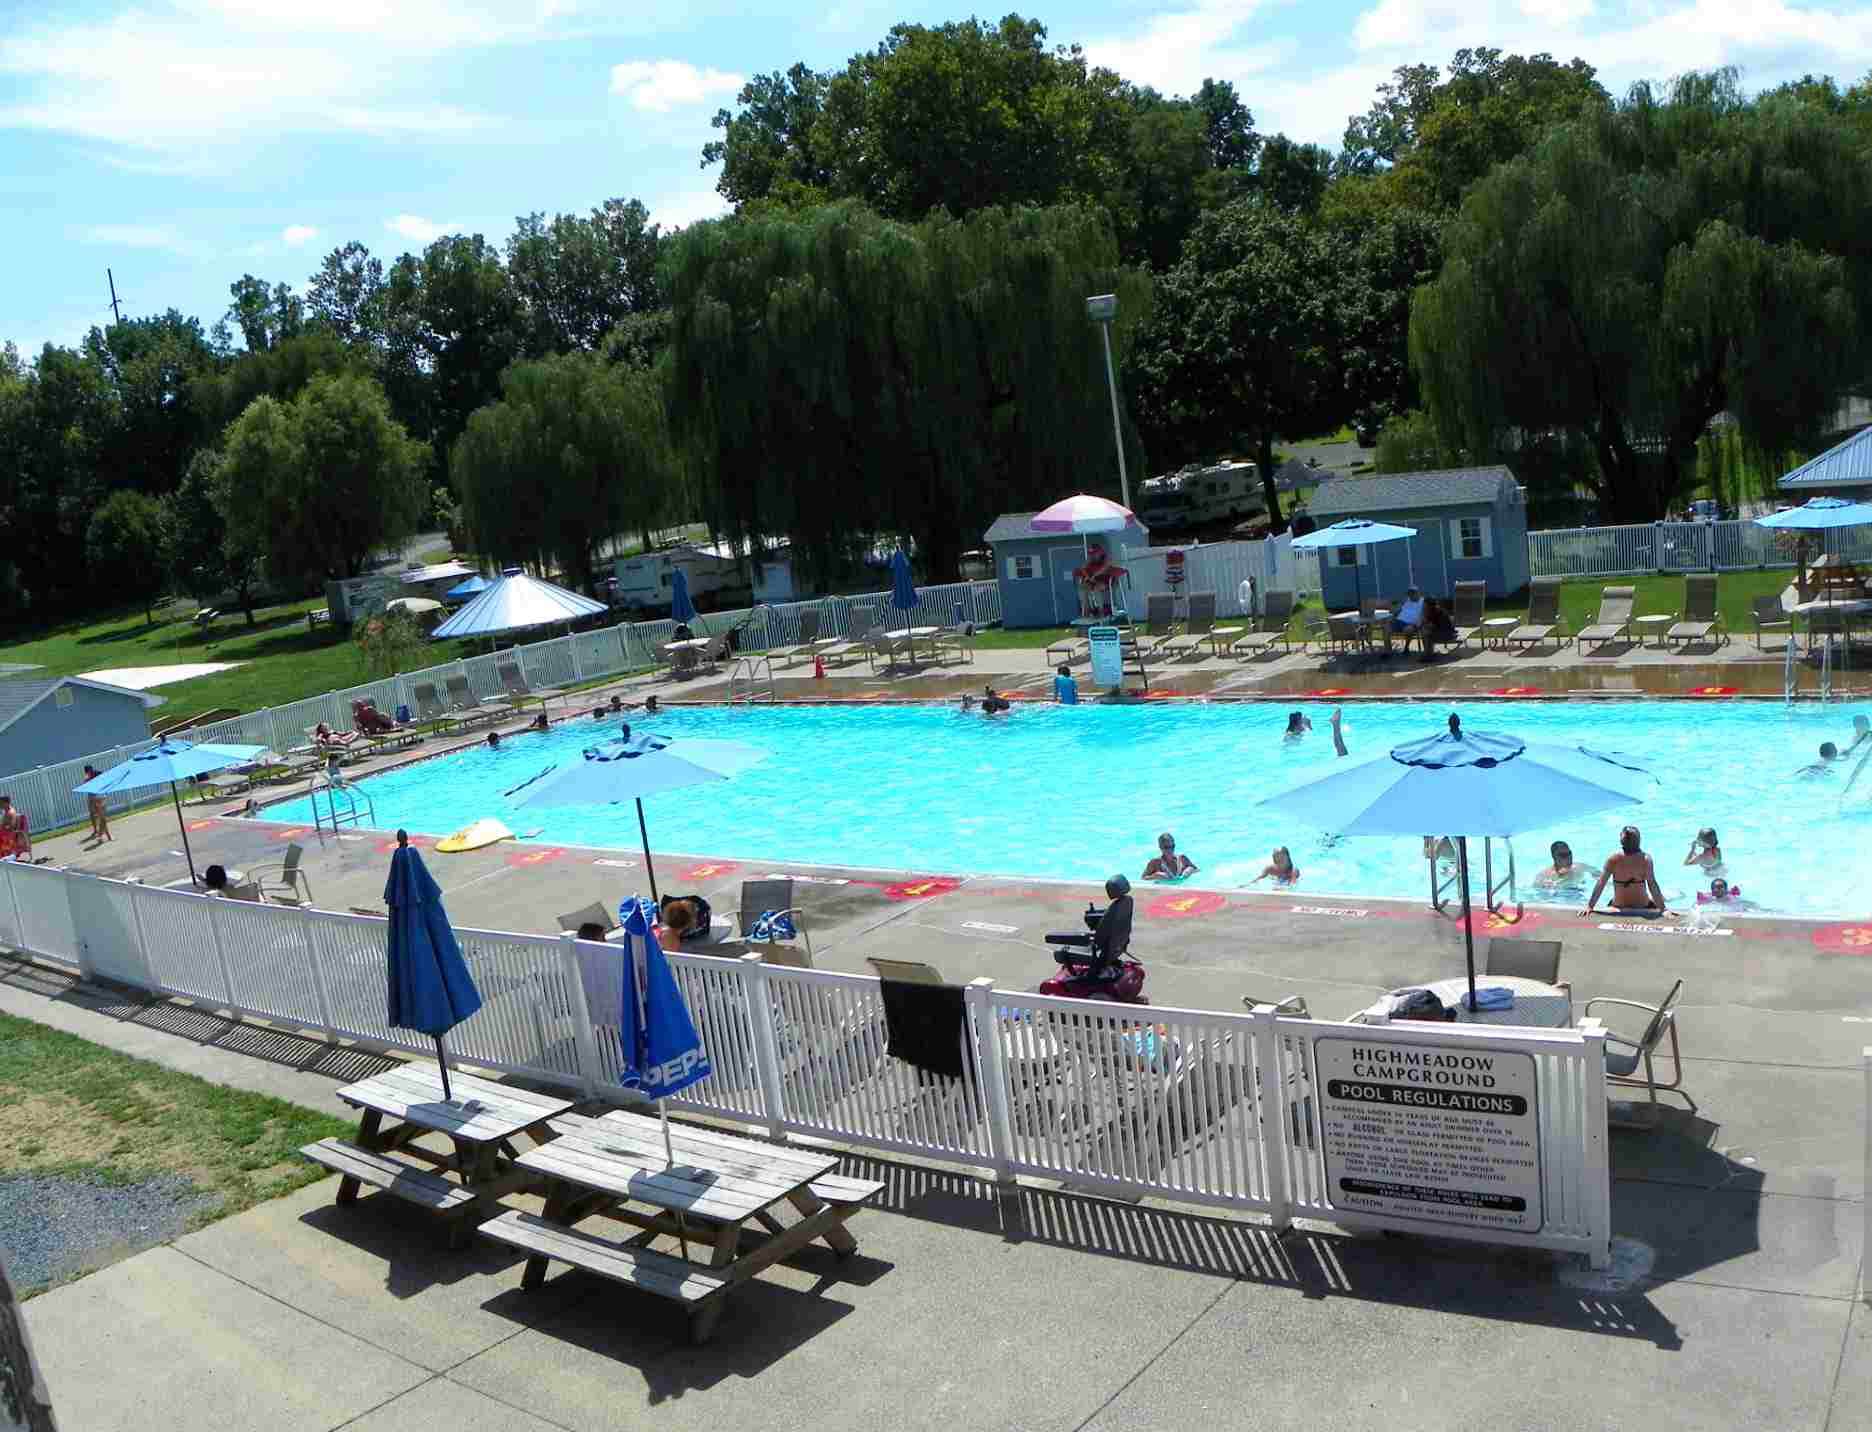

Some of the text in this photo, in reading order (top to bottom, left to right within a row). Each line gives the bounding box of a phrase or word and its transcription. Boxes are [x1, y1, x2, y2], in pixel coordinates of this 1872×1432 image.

[1352, 1048, 1494, 1071] HIGHMEADOW
[1353, 1064, 1496, 1088] CAMPGROUND
[1341, 1084, 1385, 1100] POOL
[1393, 1090, 1513, 1113] REGULATIONS
